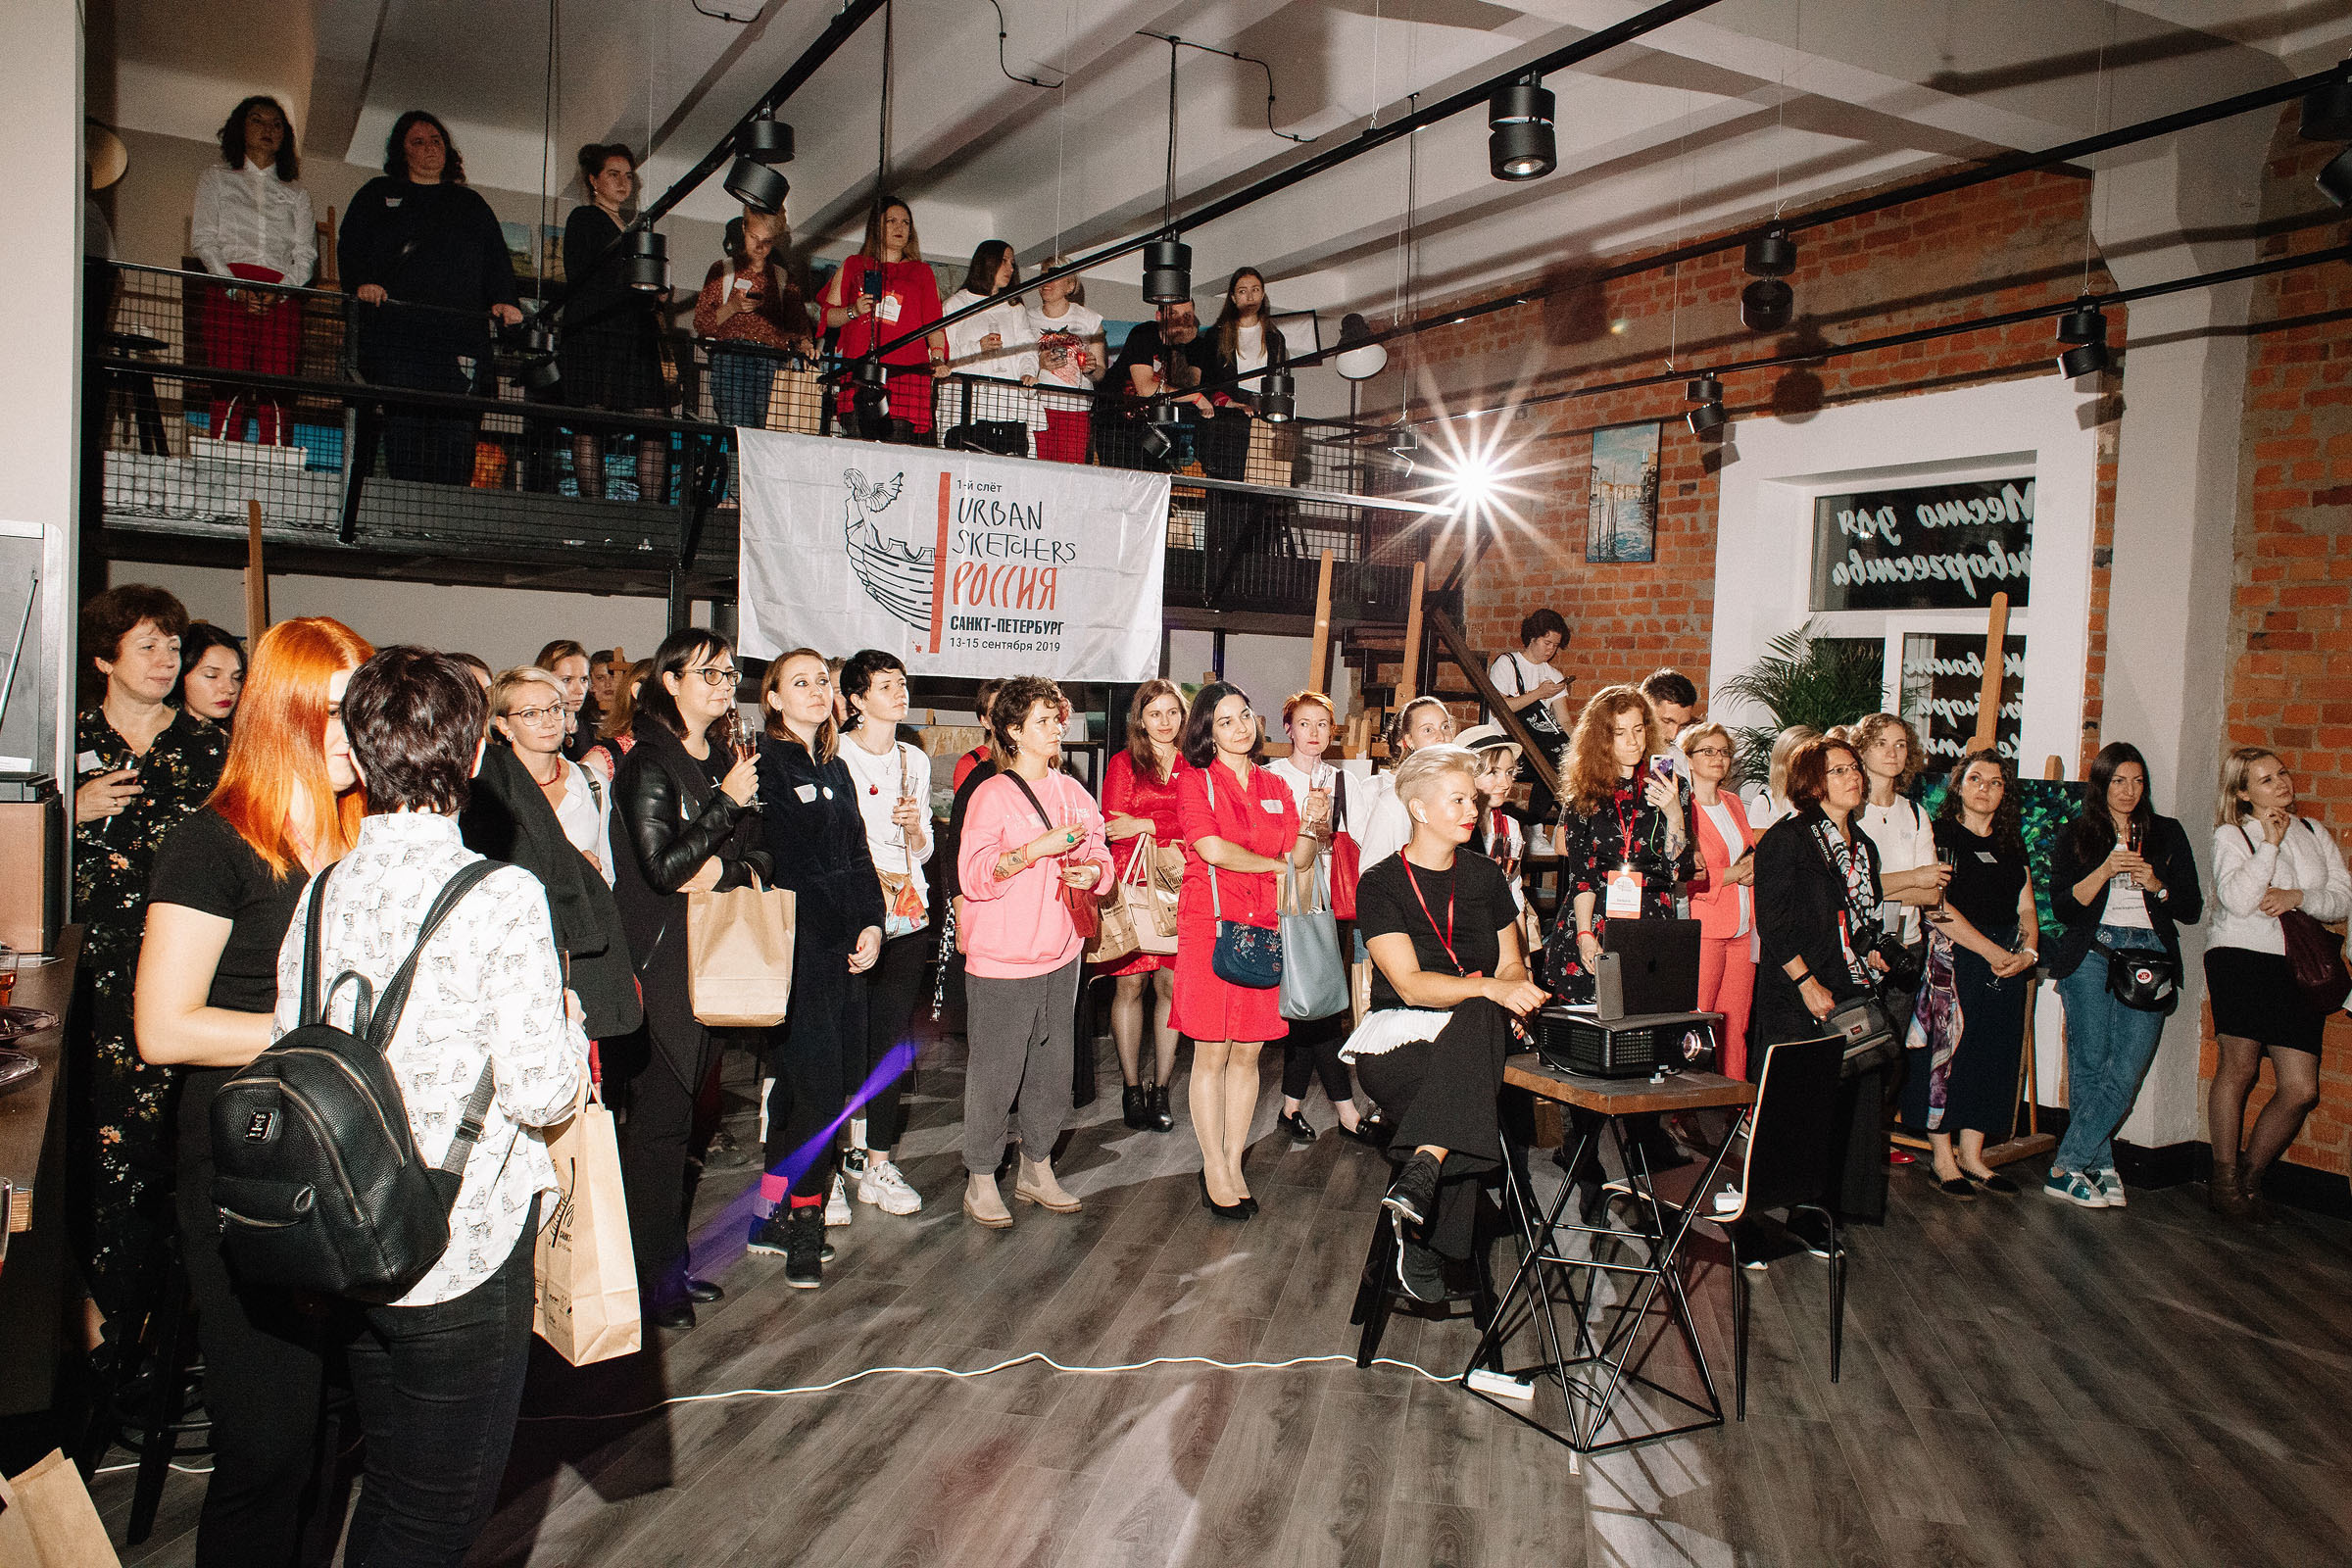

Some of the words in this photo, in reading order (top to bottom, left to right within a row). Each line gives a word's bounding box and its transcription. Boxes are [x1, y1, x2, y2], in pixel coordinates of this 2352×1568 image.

[957, 479, 973, 491] 1-й
[976, 481, 1003, 493] слёт
[957, 497, 1043, 530] URBAN
[952, 529, 1076, 564] SKETCHERS
[953, 561, 1058, 612] РОССИЯ
[950, 614, 1065, 636] САНКТ-ПЕТЕРБУРГ
[950, 637, 979, 649] 13-15
[981, 639, 1033, 653] сентября
[1036, 641, 1060, 653] 2019
